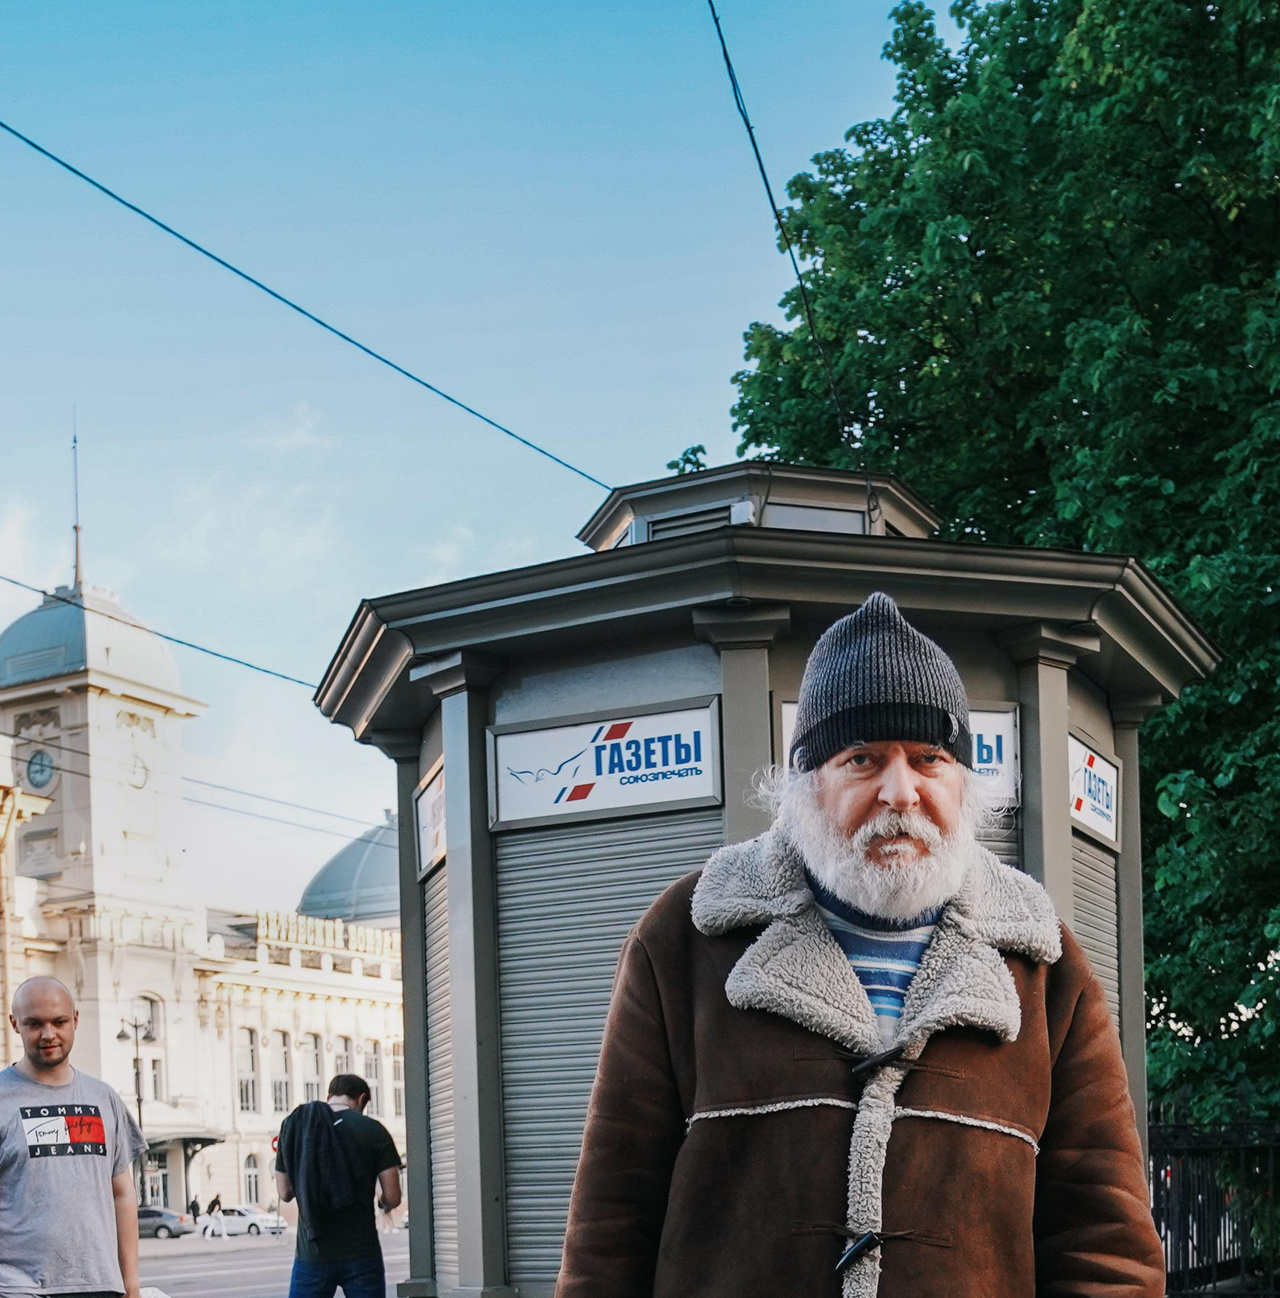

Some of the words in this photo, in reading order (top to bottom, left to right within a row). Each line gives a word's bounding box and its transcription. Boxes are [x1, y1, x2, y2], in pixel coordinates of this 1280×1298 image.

[595, 731, 702, 776] ГАЗЕТЫ
[1083, 767, 1113, 812] ГАЗЕТЫ
[25, 1106, 96, 1118] TOMMY
[35, 1144, 104, 1156] JEANS
